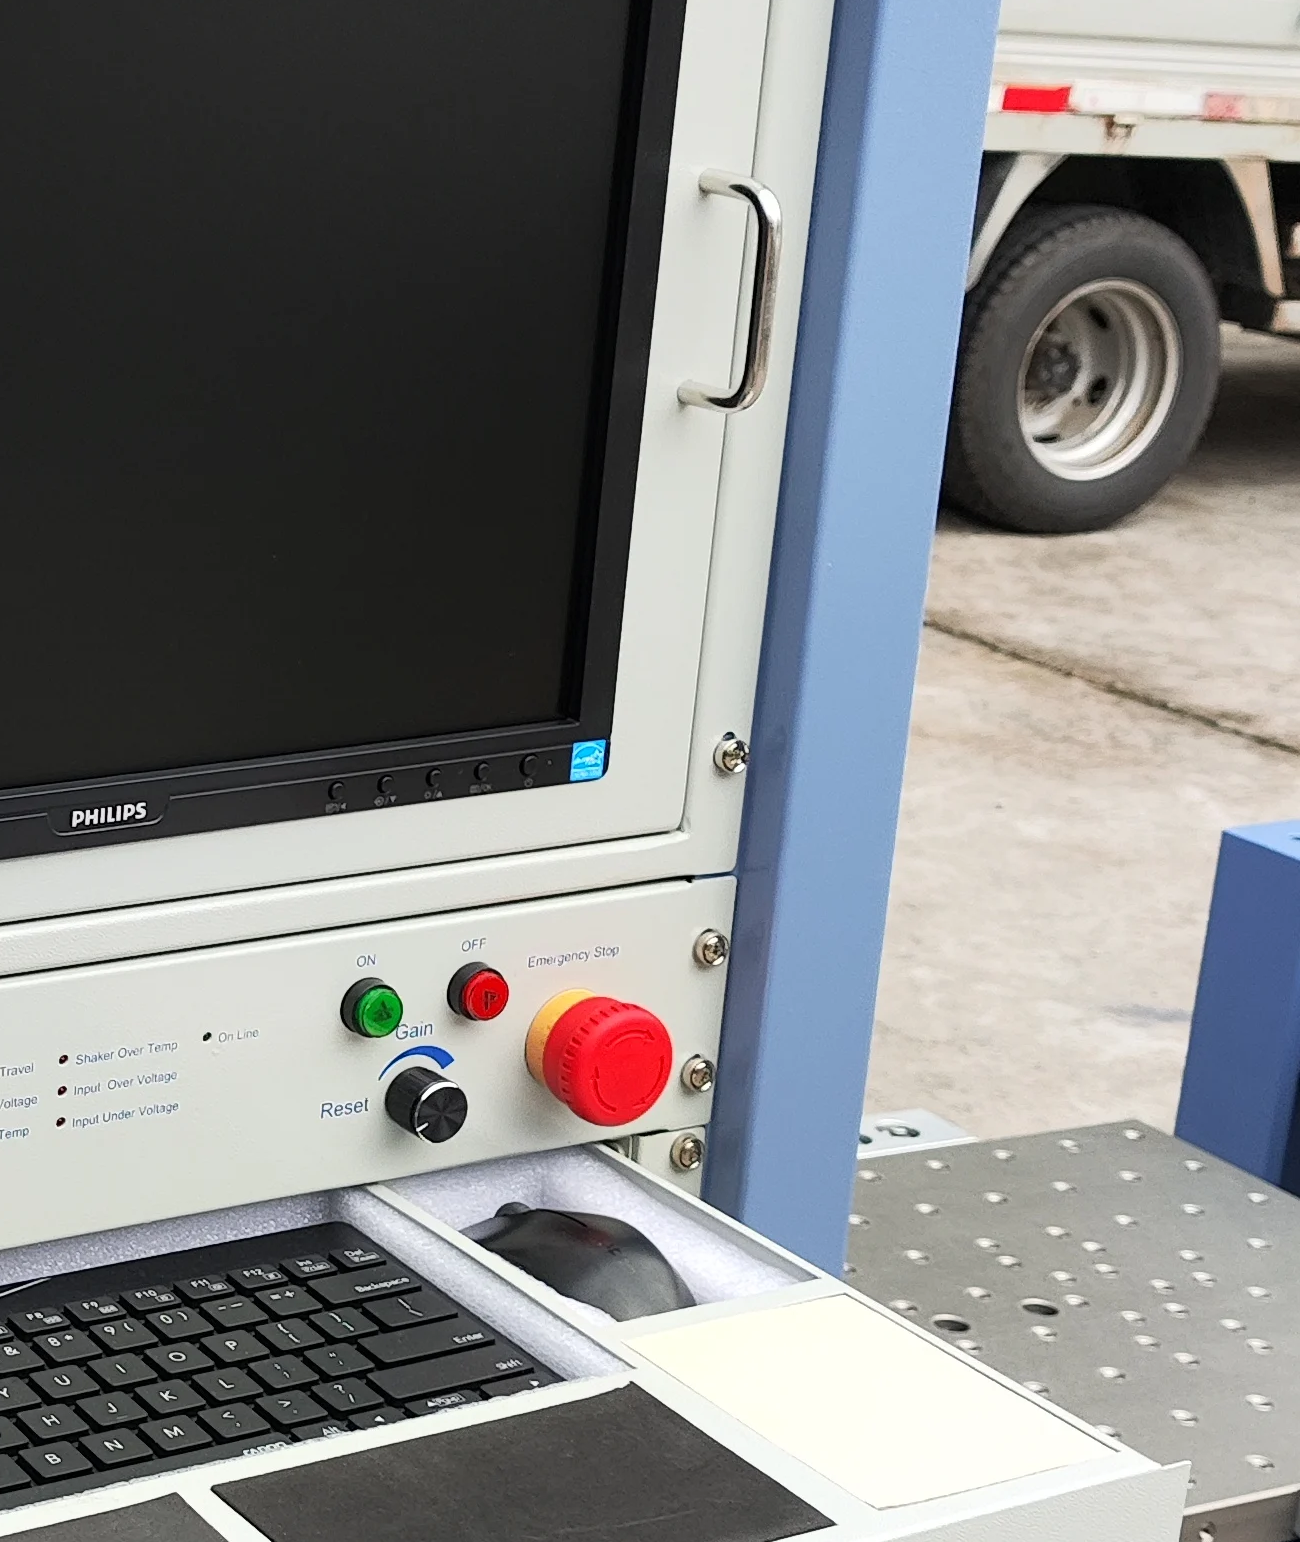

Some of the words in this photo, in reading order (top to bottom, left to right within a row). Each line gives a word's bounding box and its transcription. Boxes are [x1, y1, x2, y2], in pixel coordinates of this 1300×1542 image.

[72, 802, 147, 828] PHILIPS
[461, 937, 487, 953] OFF
[356, 953, 377, 968] ON
[527, 950, 590, 968] Emergency
[594, 945, 620, 958] Stop
[218, 1032, 234, 1043] On
[237, 1027, 259, 1040] Line
[395, 1021, 434, 1041] Gain
[75, 1050, 114, 1065] Shaker
[117, 1046, 144, 1059] Over
[147, 1040, 178, 1054] Temp
[0, 1063, 34, 1077] Travel
[73, 1081, 101, 1096] Input
[107, 1077, 134, 1090] Over
[137, 1070, 177, 1085] Voltage
[72, 1114, 100, 1128] Input
[102, 1109, 135, 1123] Under
[138, 1101, 179, 1116] Voltage
[320, 1097, 370, 1119] Reset
[224, 1340, 238, 1351] P
[53, 1374, 71, 1386] U
[218, 1378, 235, 1389] L
[159, 1389, 177, 1402] K
[107, 1402, 118, 1414] J
[41, 1414, 60, 1426] H
[162, 1425, 185, 1439] M
[103, 1438, 124, 1451] N
[44, 1453, 62, 1465] B
